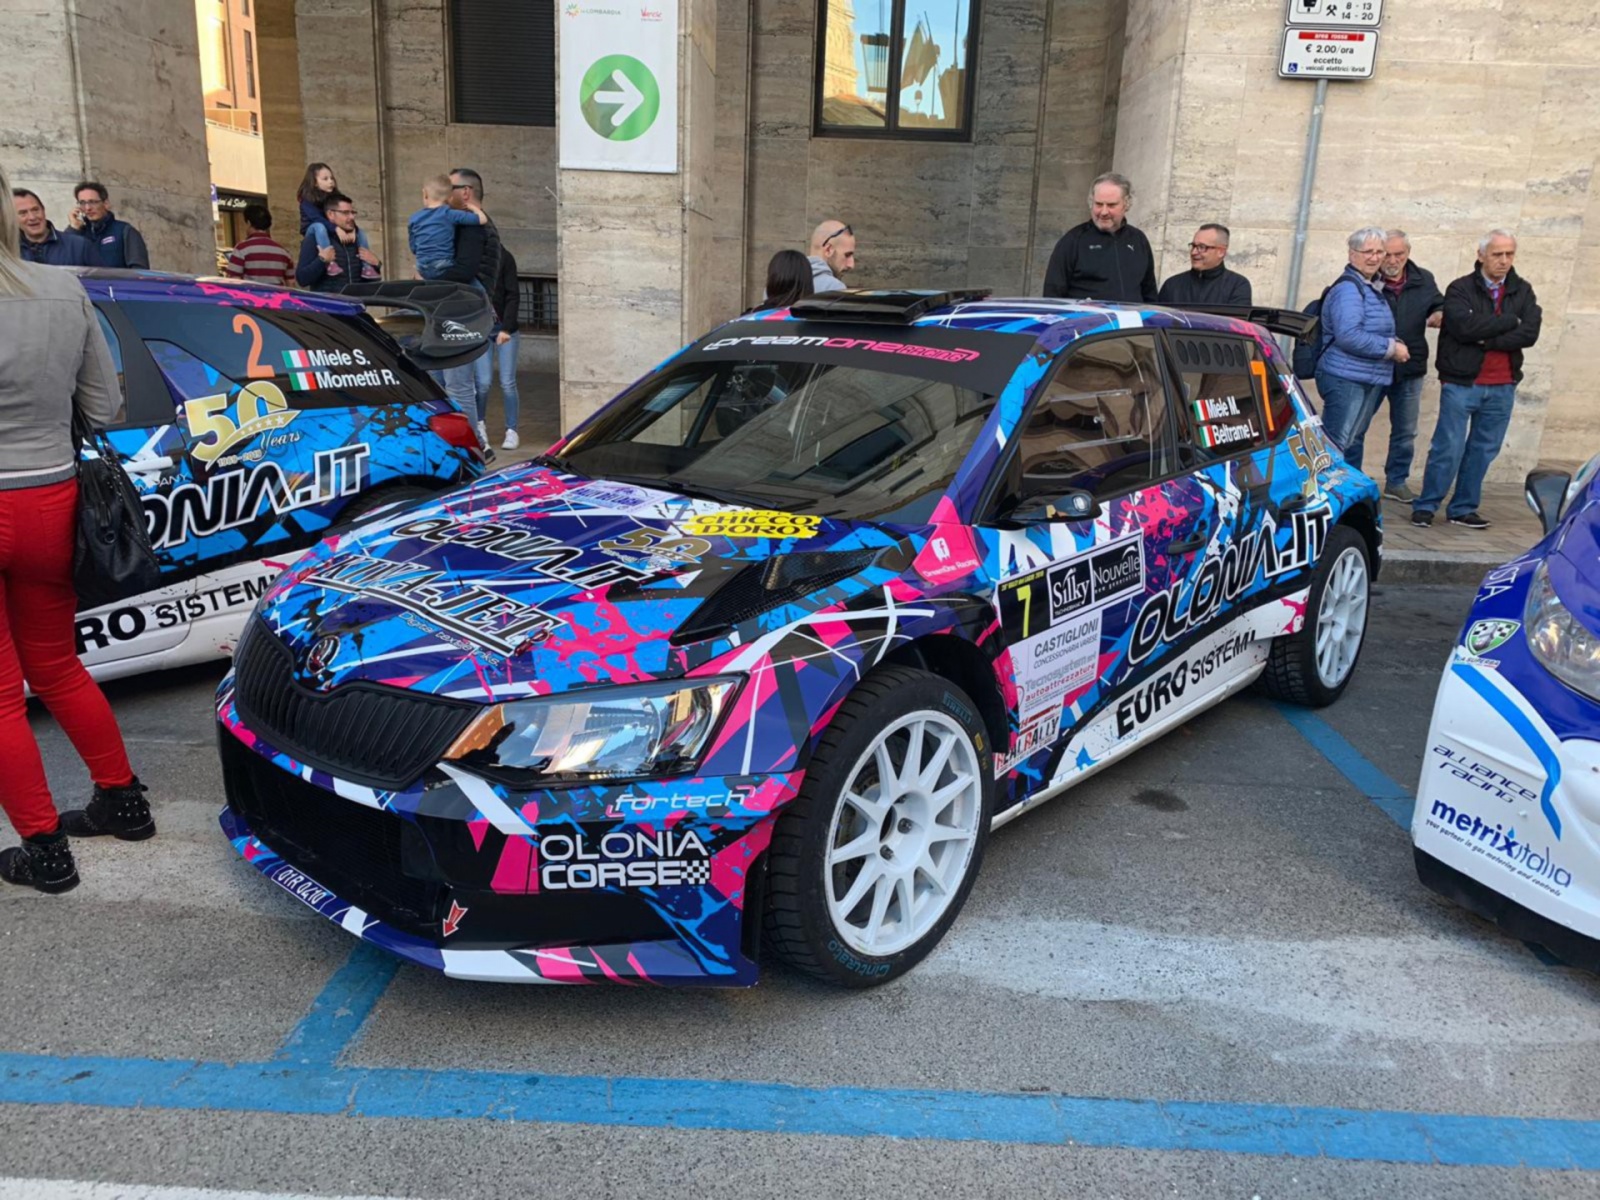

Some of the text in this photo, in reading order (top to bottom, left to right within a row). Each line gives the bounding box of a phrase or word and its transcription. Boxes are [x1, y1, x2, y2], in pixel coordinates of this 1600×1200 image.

[1342, 12, 1351, 20] 14
[1361, 12, 1374, 21] 20
[1346, 2, 1352, 10] 8
[1305, 44, 1313, 53] €
[1313, 57, 1342, 65] eccetto
[233, 313, 274, 378] 2
[309, 349, 371, 368] Miele S.
[315, 368, 400, 390] Mometti R.
[1206, 395, 1241, 419] Miele M.
[1250, 361, 1274, 431] 7
[184, 380, 291, 463] 50
[1212, 418, 1260, 445] Beltrame L.
[261, 428, 301, 462] Years
[695, 515, 813, 525] CHICCO
[701, 525, 801, 535] D'ORO
[598, 526, 712, 558] 50
[1093, 547, 1141, 587] Nouvelle
[1053, 568, 1090, 609] Silky
[1016, 584, 1032, 639] 7
[1034, 617, 1099, 658] CASTIGLIONI
[1025, 663, 1096, 702] autoattrezzature
[1117, 661, 1188, 740] EURO
[1191, 630, 1256, 685] SISTEMI
[540, 830, 709, 861] OLONIA
[1425, 818, 1562, 897] your partner in gas metering and controls
[542, 860, 683, 890] CORSE
